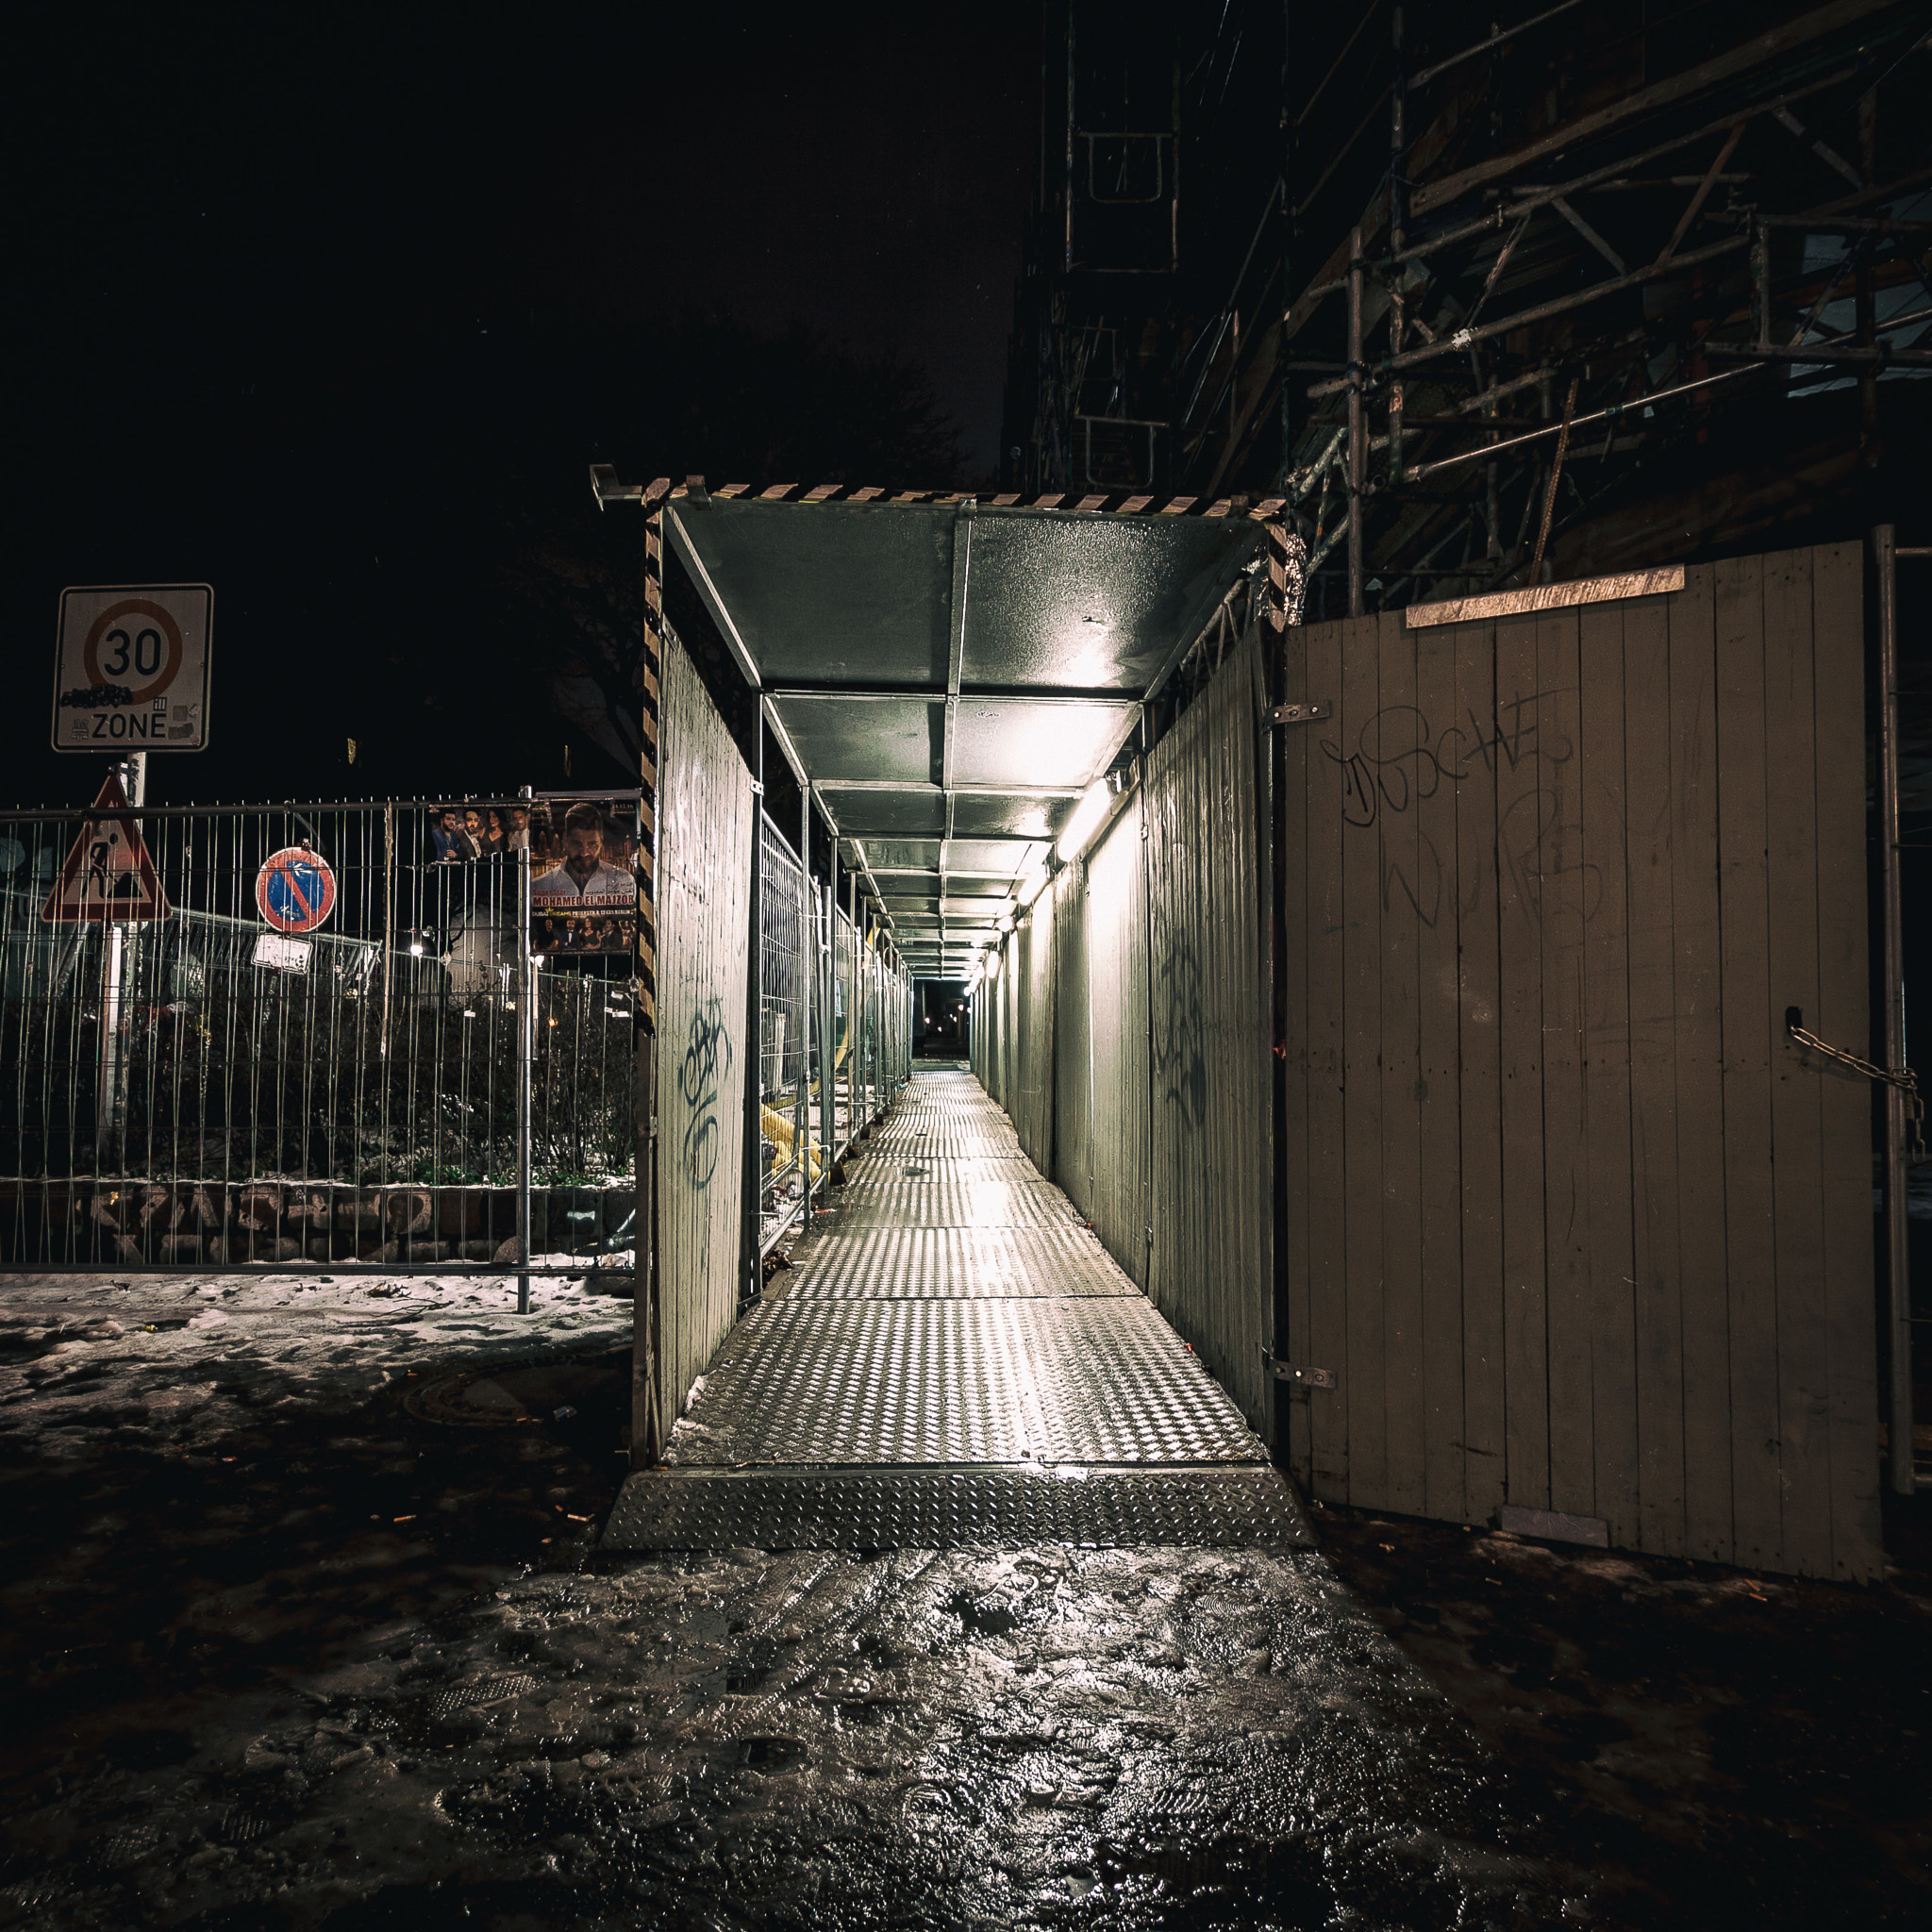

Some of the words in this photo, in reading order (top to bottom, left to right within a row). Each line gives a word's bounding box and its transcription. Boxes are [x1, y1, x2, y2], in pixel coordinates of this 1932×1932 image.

[104, 628, 161, 675] 30
[92, 713, 167, 739] ZONE
[532, 896, 583, 907] MOHAMED
[584, 895, 595, 906] EL
[596, 894, 635, 906] MAJZOB
